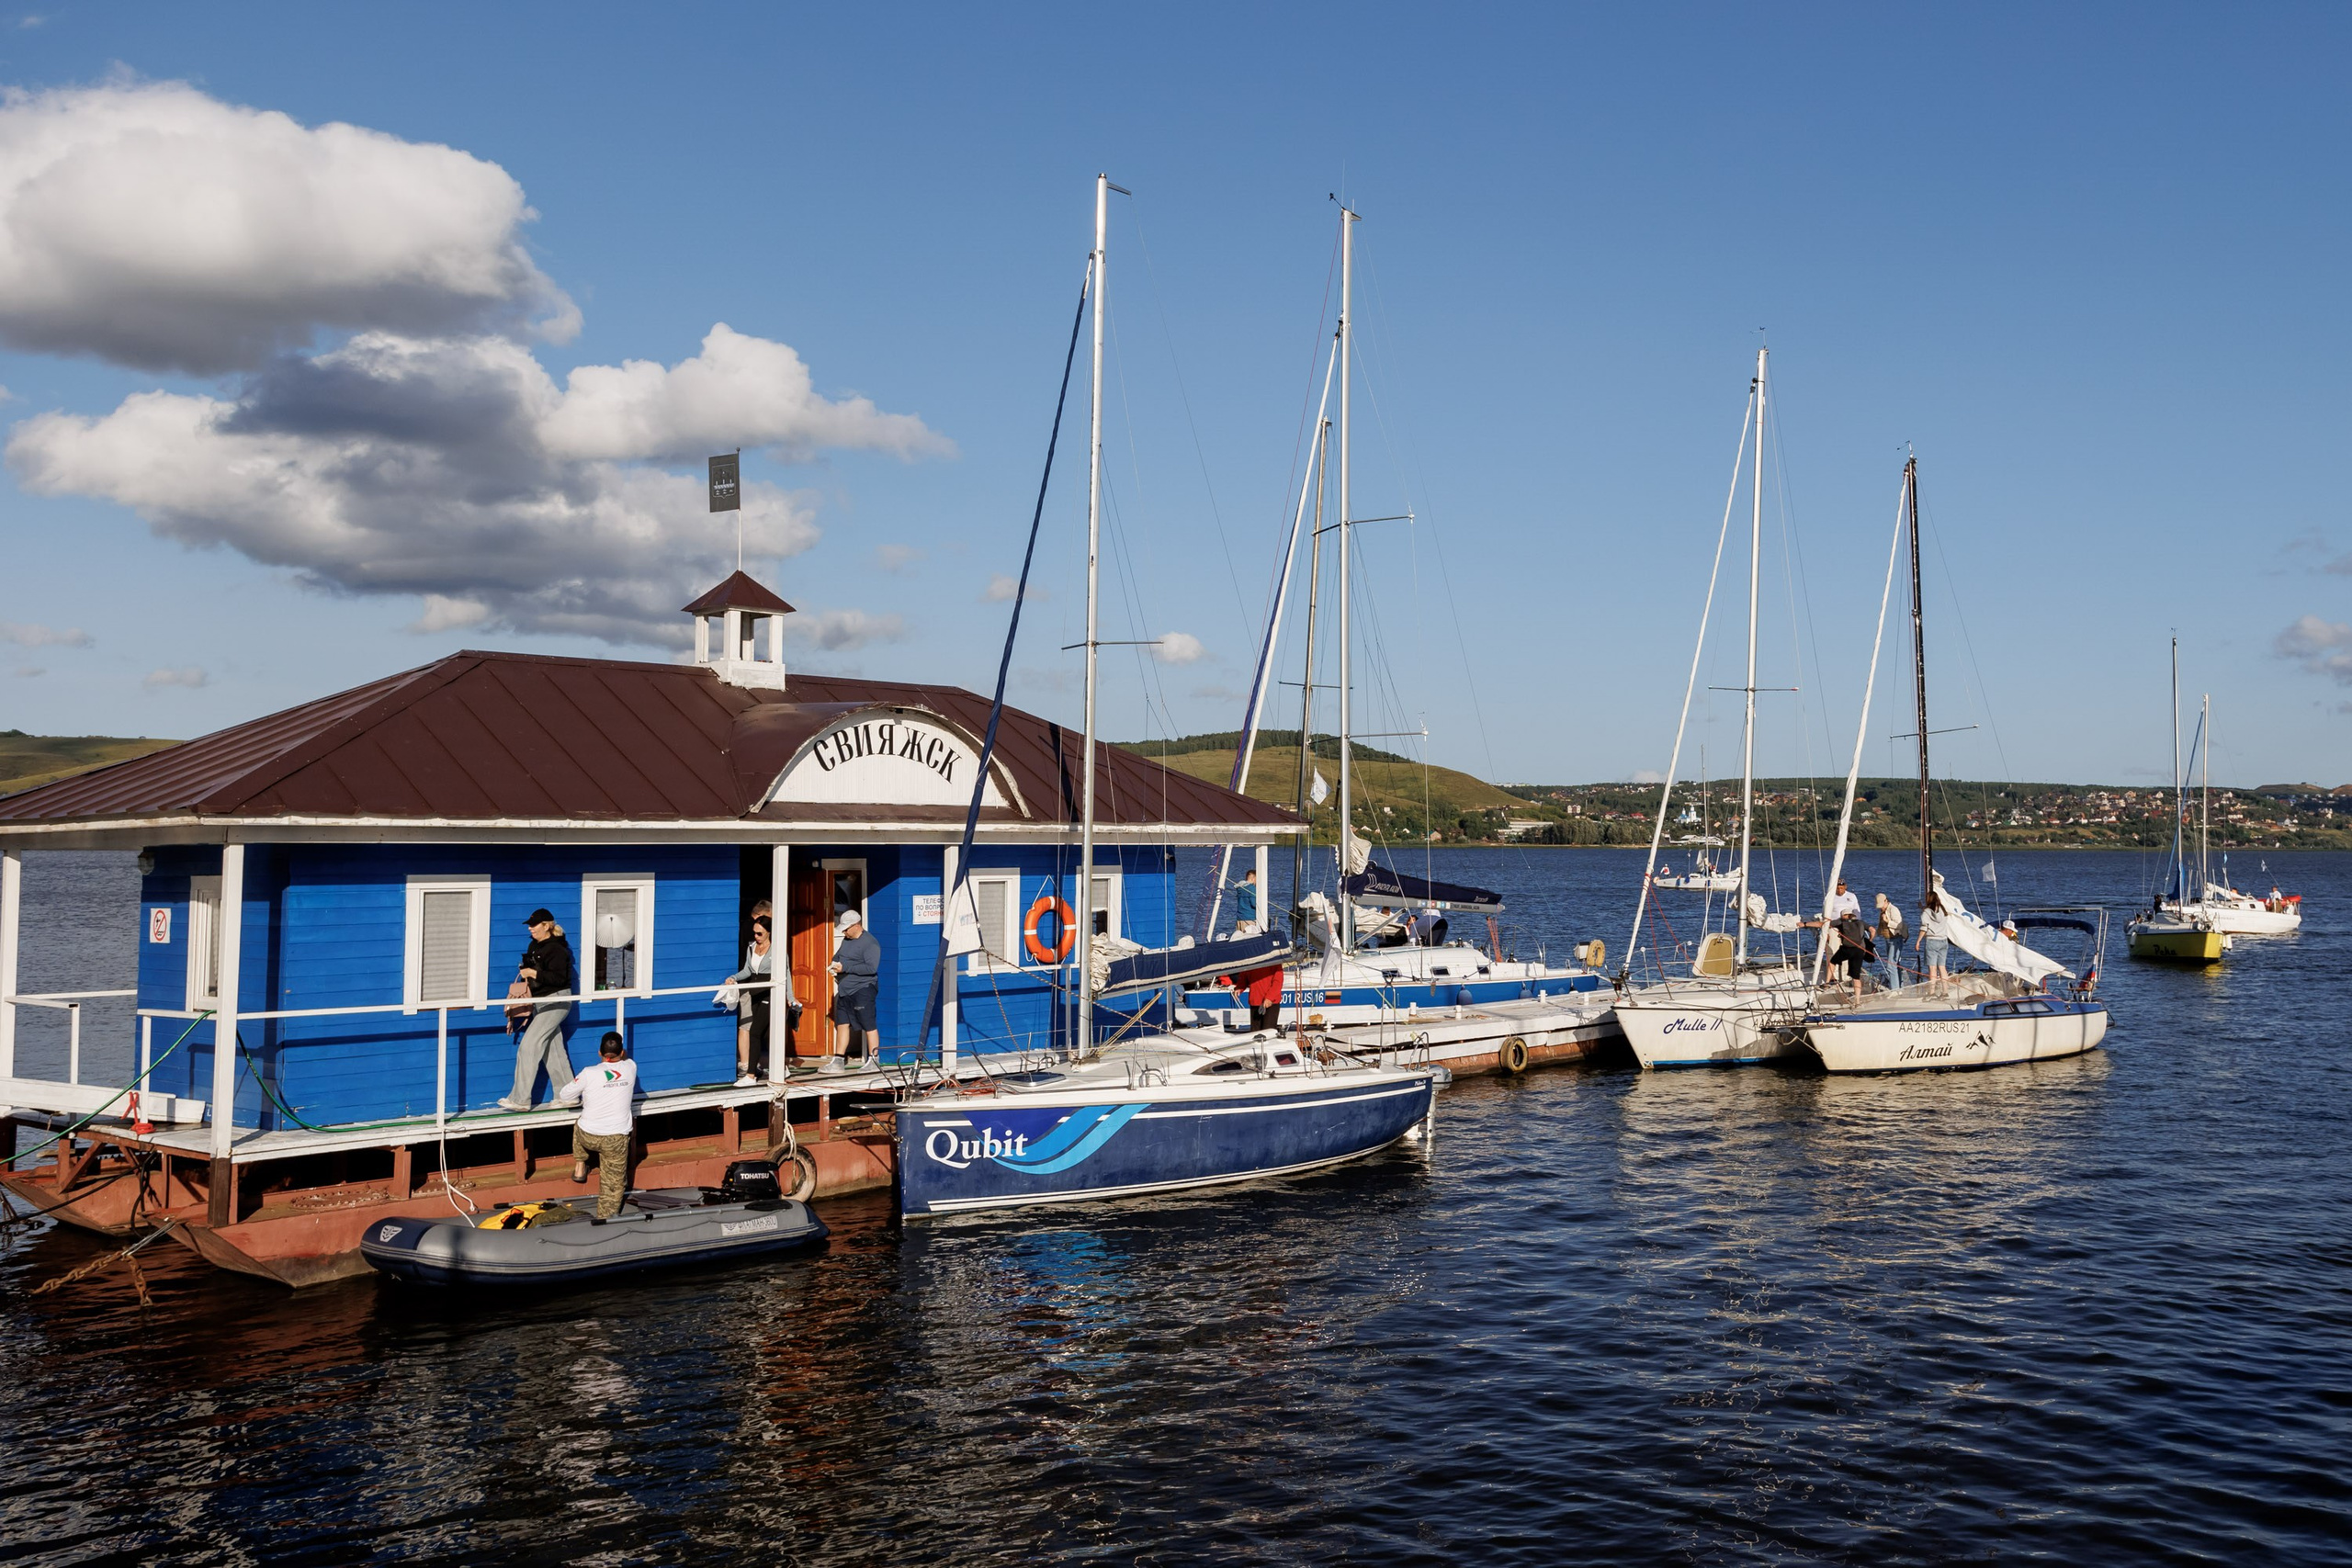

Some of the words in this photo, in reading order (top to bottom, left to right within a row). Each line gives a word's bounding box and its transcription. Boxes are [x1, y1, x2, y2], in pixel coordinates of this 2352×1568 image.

[813, 724, 962, 784] СВИЯЖСК
[1295, 992, 1313, 1003] RUS
[1315, 992, 1324, 1003] 16
[1664, 1018, 1706, 1034] Mulle
[1899, 1042, 1954, 1062] Алтай
[925, 1127, 1029, 1169] Qubit
